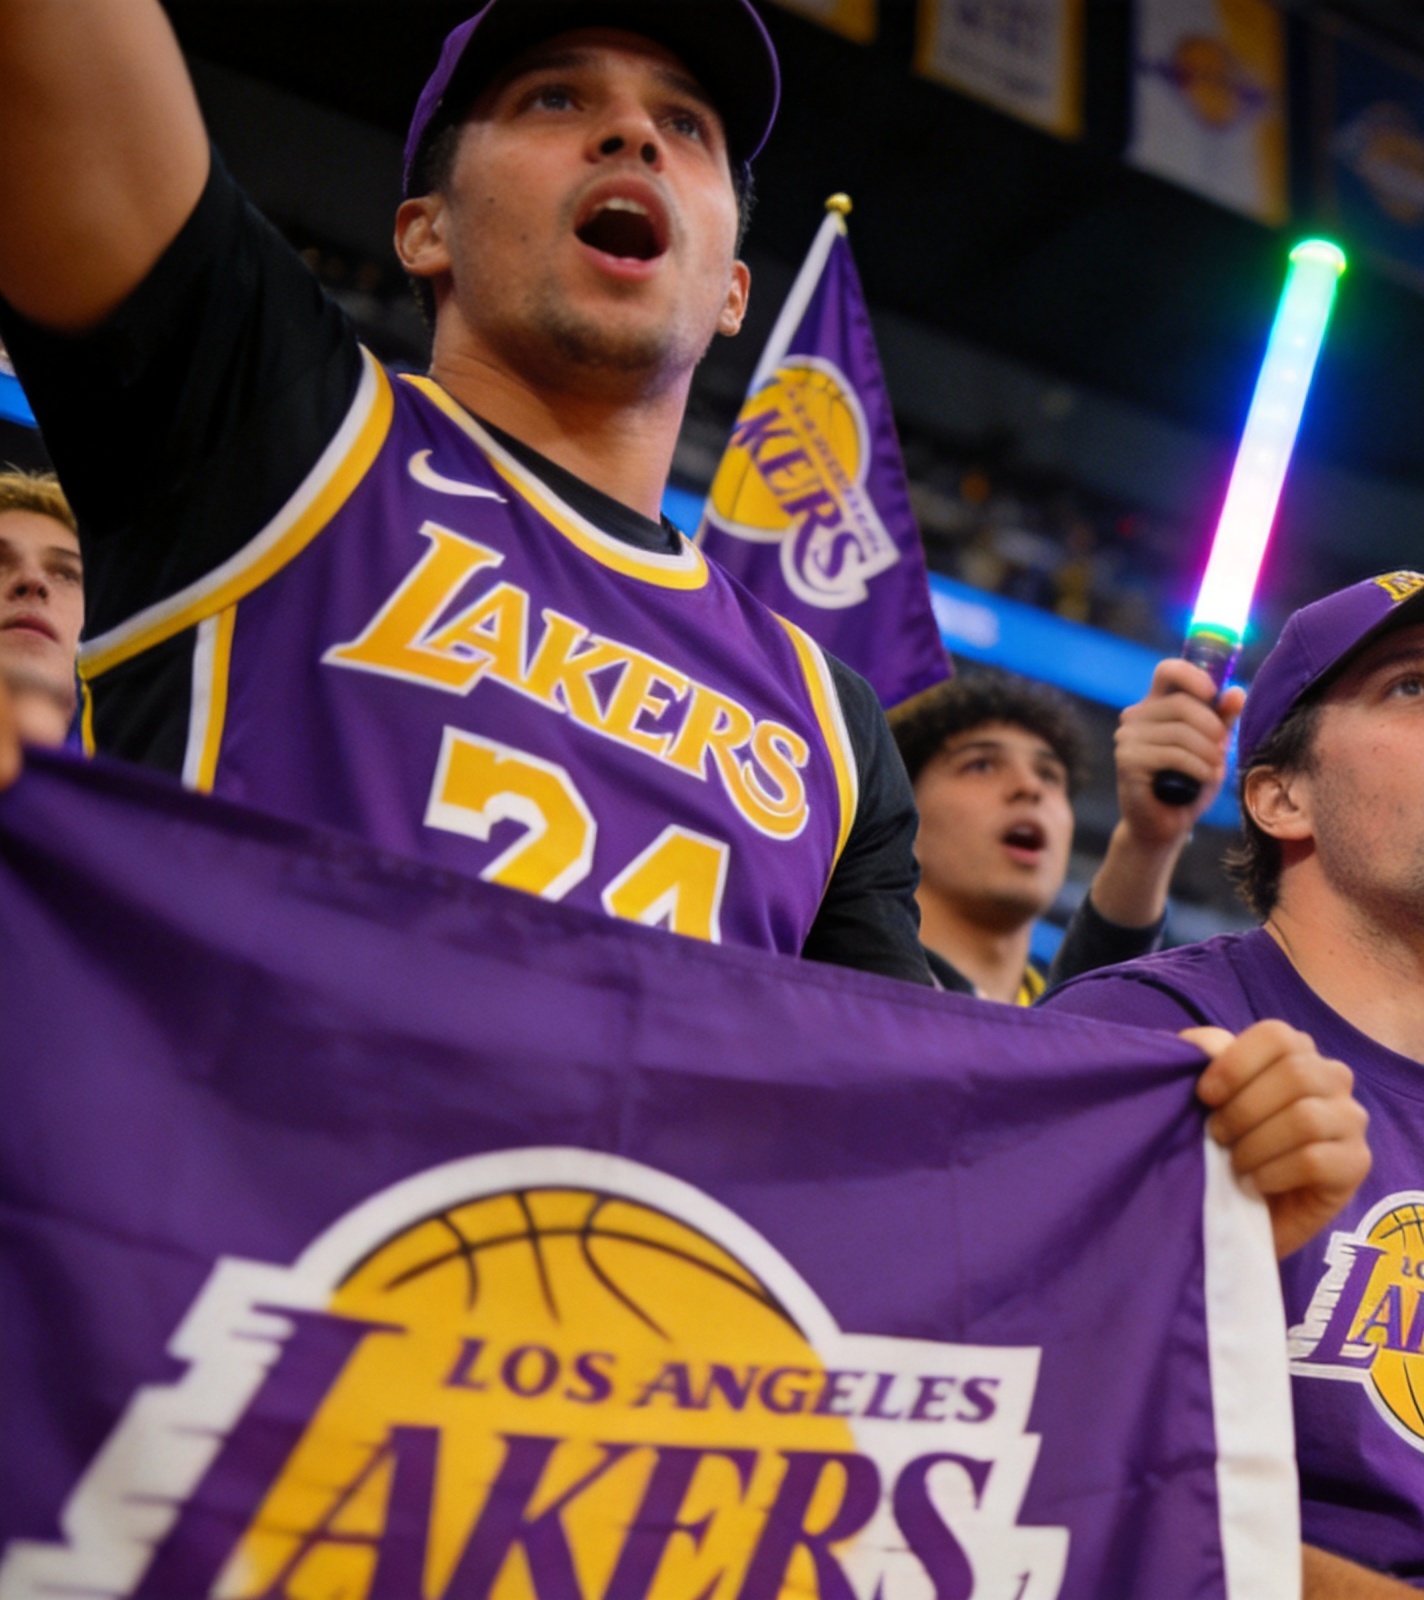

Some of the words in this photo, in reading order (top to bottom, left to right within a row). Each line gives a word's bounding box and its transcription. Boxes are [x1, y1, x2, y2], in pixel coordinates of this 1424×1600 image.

[732, 408, 867, 595] KERS
[320, 520, 810, 842] LAKERS
[443, 1337, 616, 1406] LOS
[628, 1361, 1000, 1425] ANGELES
